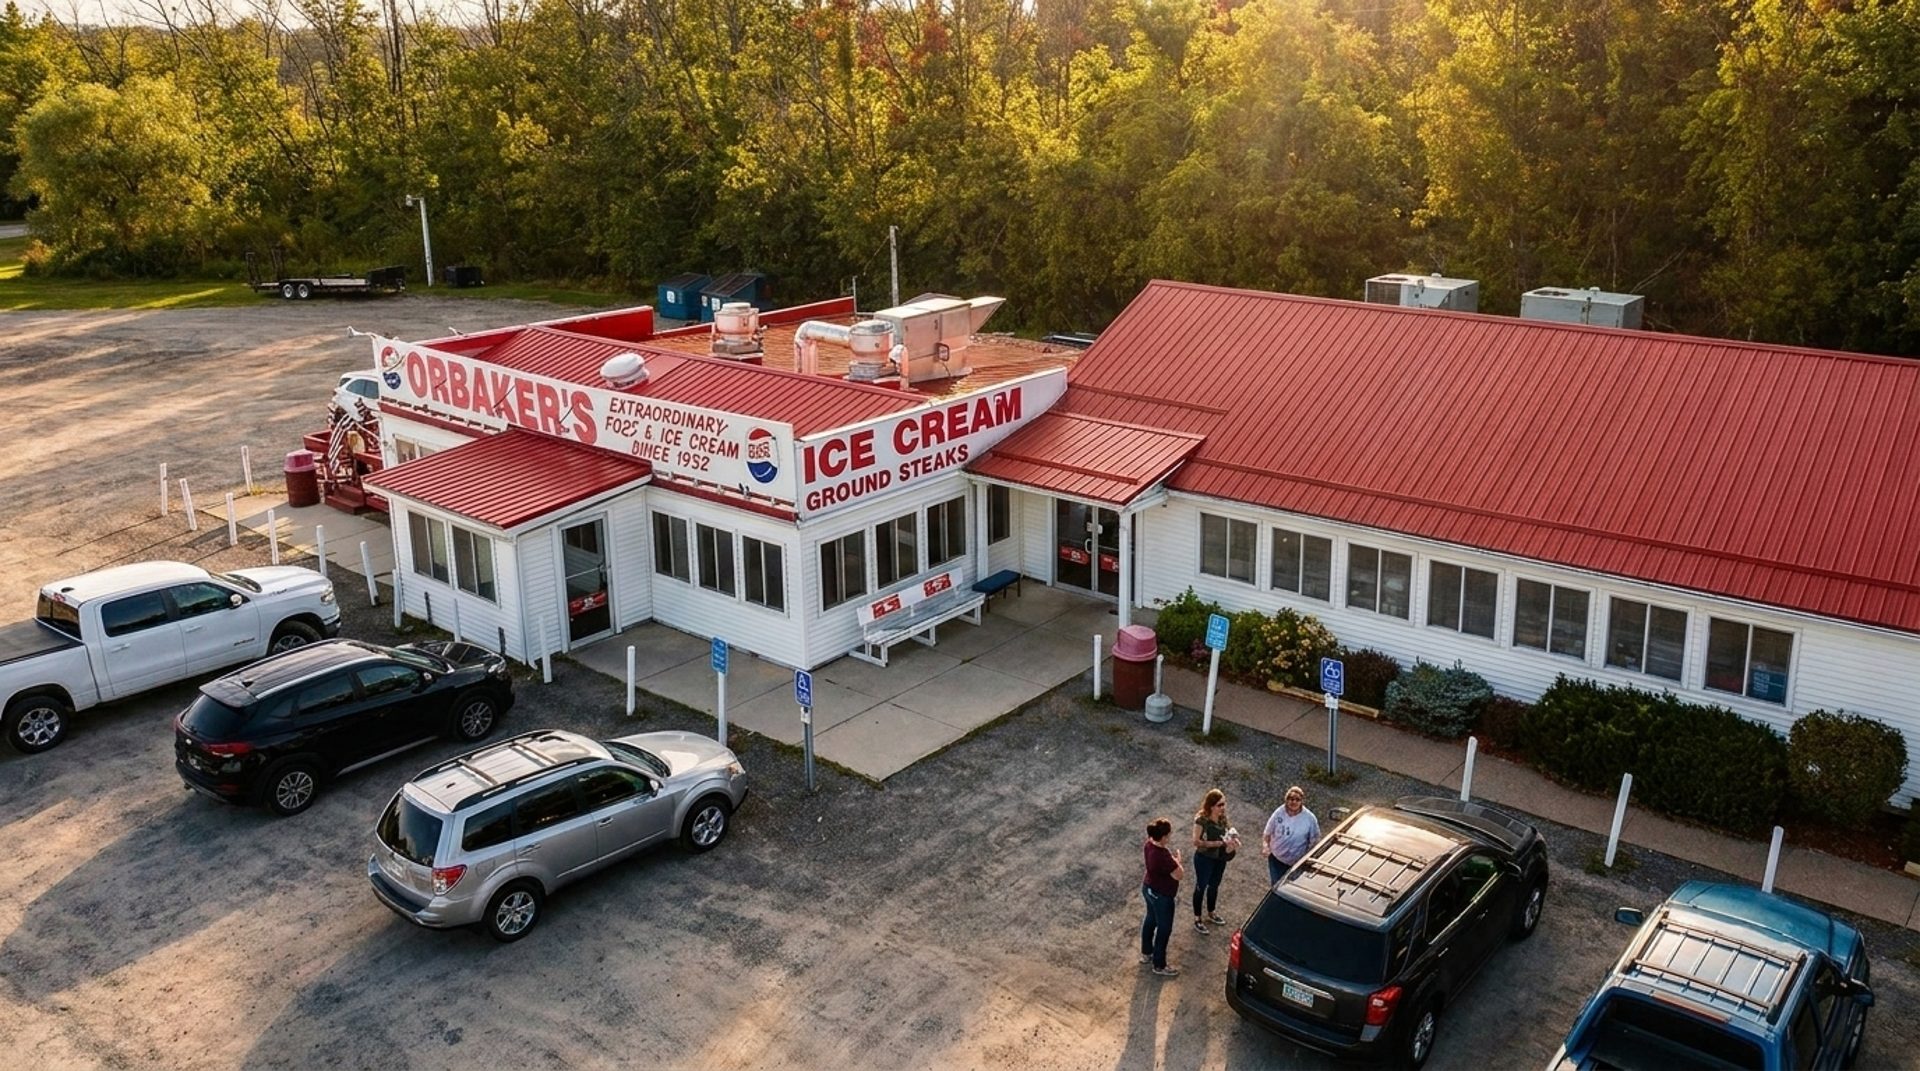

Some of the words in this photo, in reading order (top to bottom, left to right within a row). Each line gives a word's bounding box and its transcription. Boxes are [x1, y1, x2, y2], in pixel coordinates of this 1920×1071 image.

[406, 351, 597, 444] ORBAKER'S
[609, 397, 728, 436] EXTRAORDINARY
[660, 428, 683, 446] ICE
[689, 434, 739, 459] CREAM
[804, 429, 875, 484] ICE
[893, 387, 1022, 455] CREAM
[806, 469, 891, 511] GROUND
[899, 444, 969, 482] STEAKS
